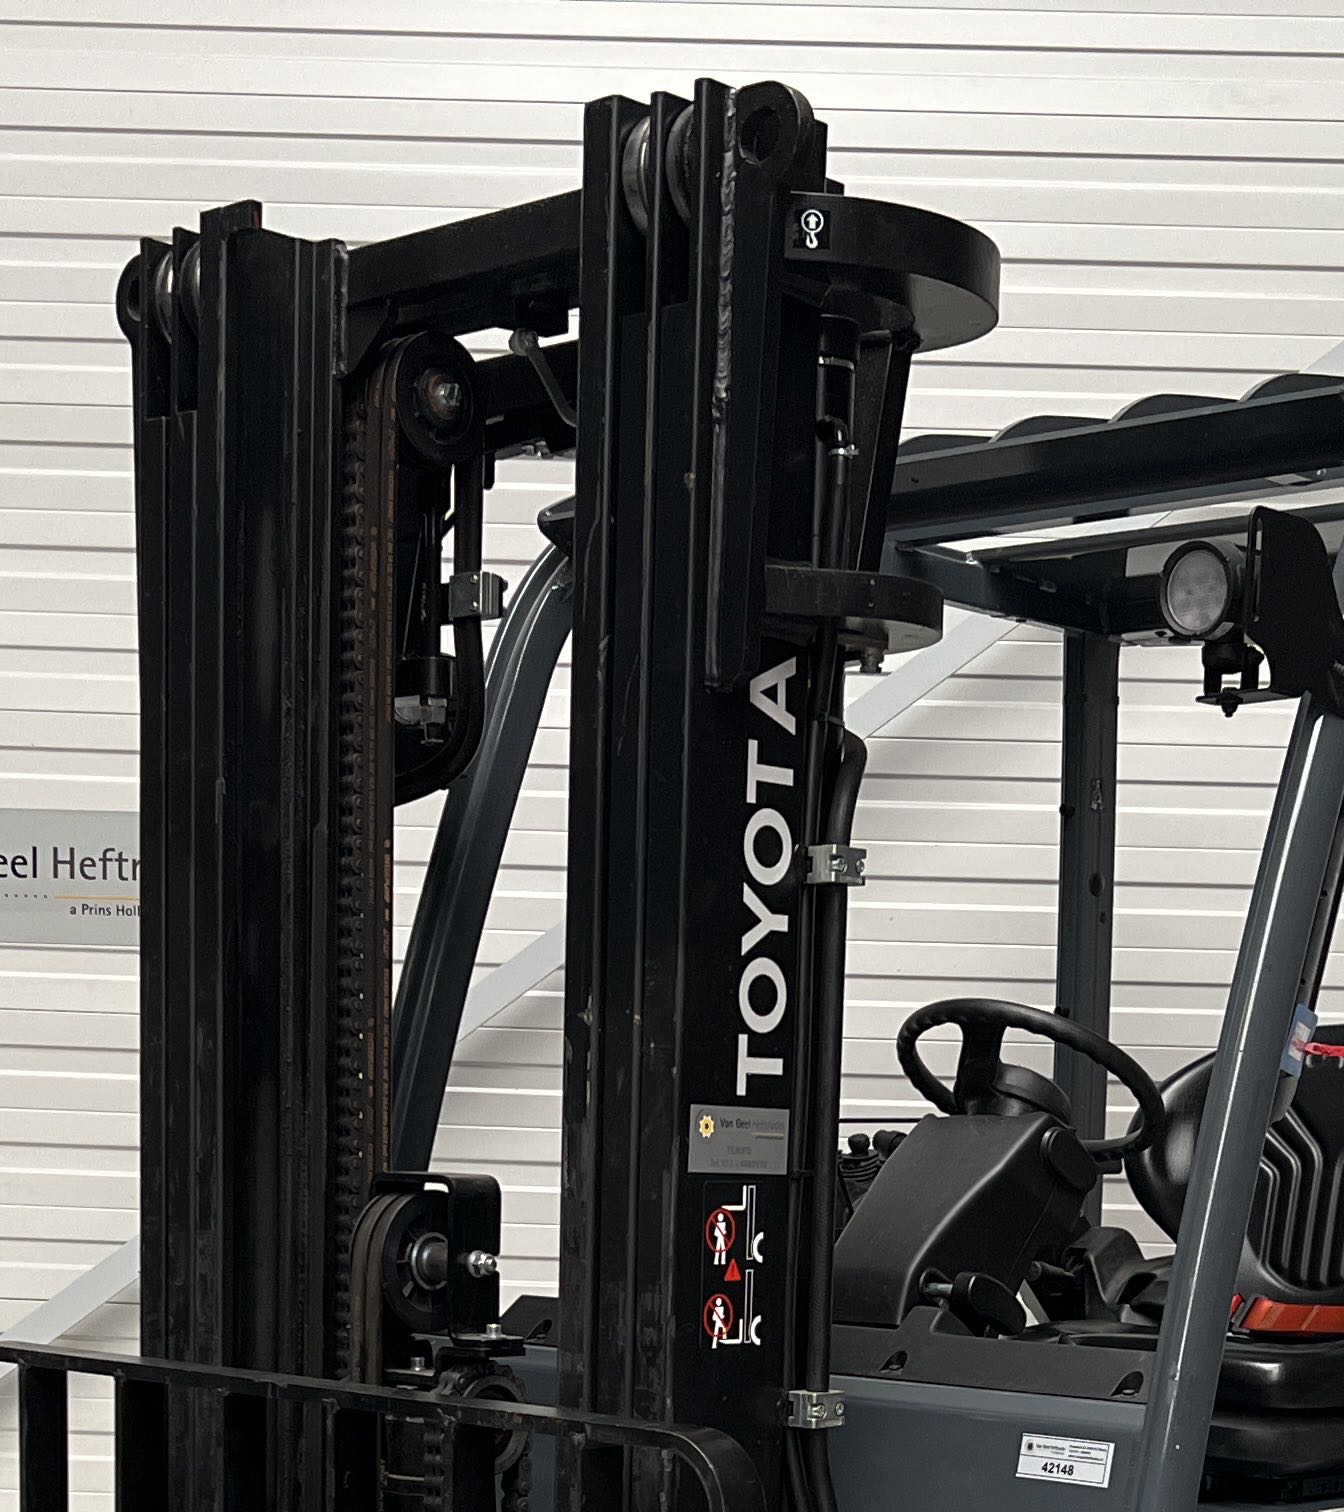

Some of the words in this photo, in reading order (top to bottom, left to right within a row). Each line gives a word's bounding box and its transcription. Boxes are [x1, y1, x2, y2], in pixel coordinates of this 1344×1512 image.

[735, 655, 798, 1097] TOYOTA
[81, 903, 112, 917] Prins
[1040, 1461, 1075, 1476] 42148
